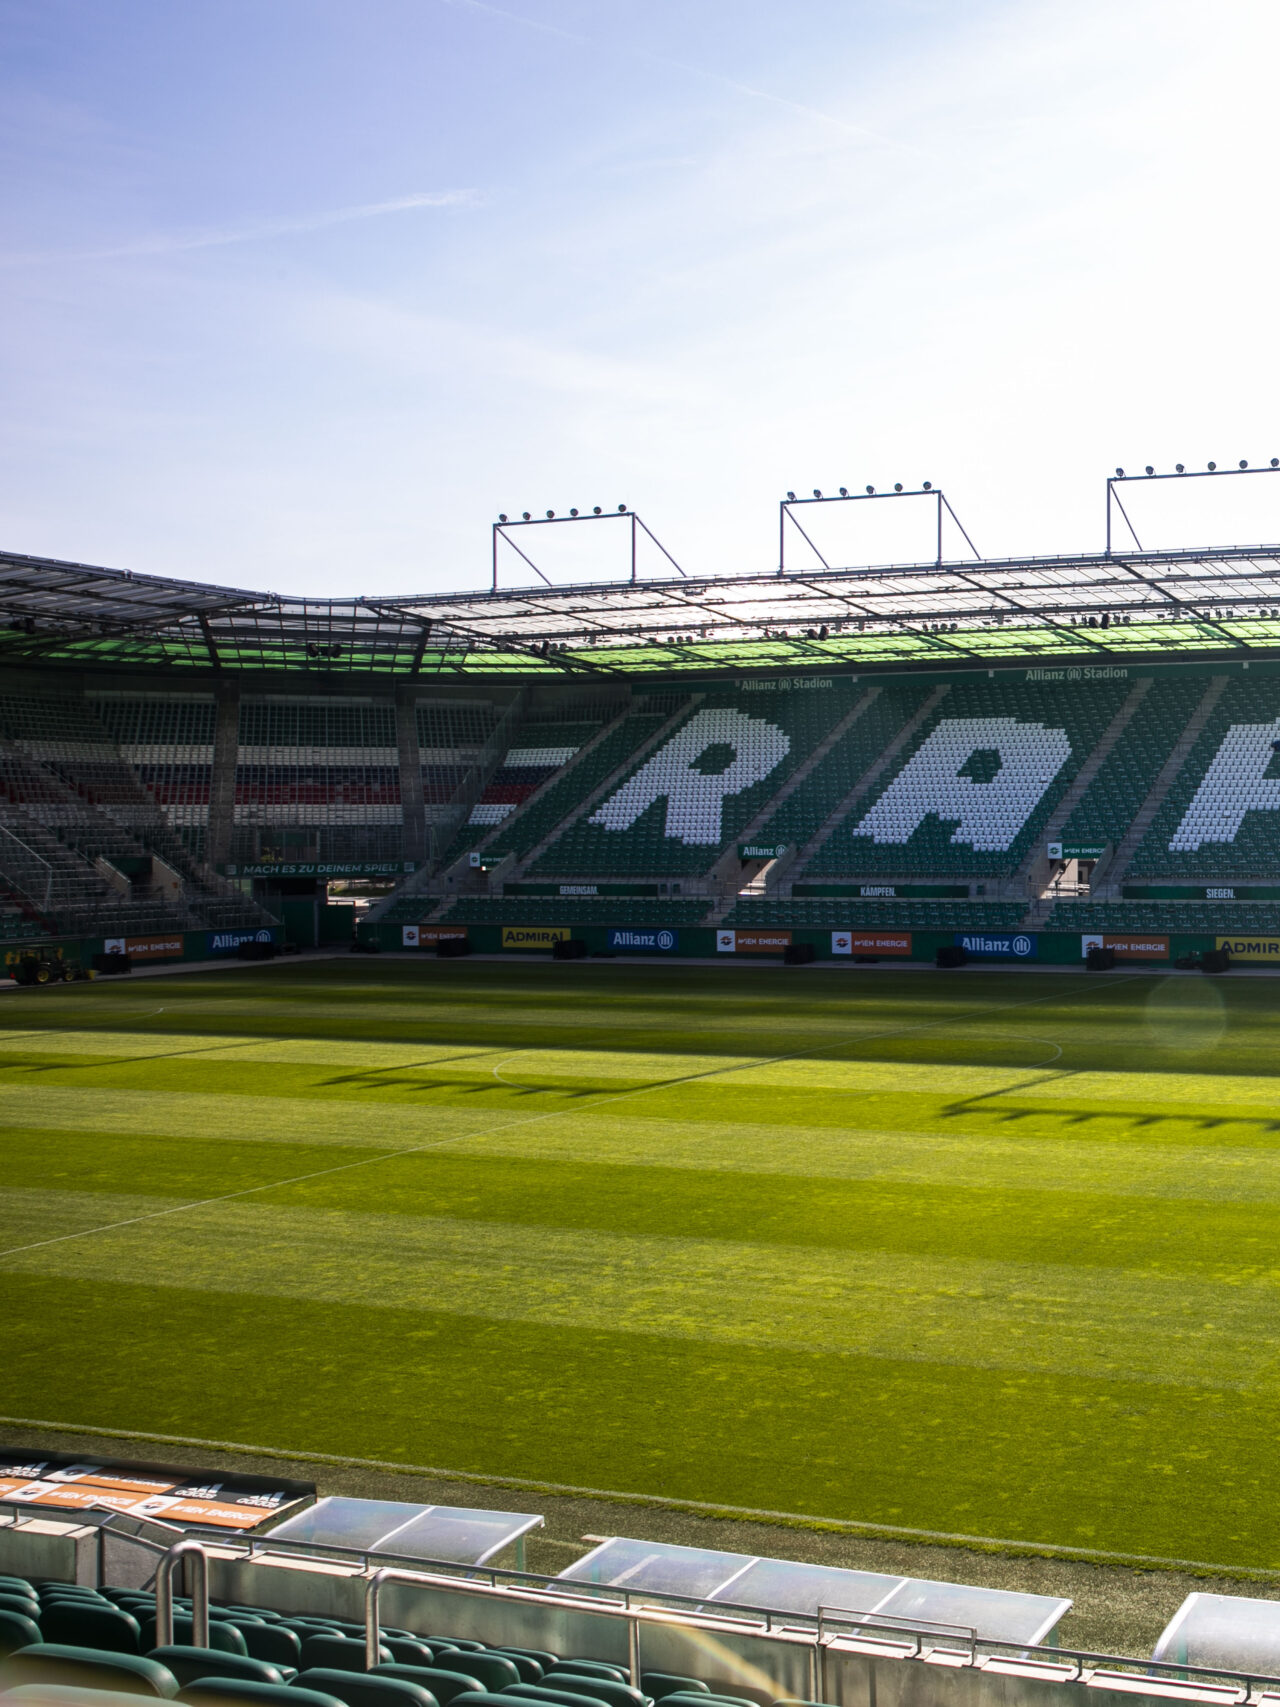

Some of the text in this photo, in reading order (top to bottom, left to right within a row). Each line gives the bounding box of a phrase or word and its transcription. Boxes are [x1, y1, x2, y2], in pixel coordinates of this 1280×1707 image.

[1025, 667, 1128, 680] Allianz Stadion
[741, 678, 833, 690] Allianz Stadion
[743, 846, 774, 856] Allianz
[243, 863, 399, 874] MACH ES ZU DEINEM SPIEL!
[1206, 888, 1236, 899] SIEGEN.
[613, 932, 656, 946] Allianz
[962, 937, 1010, 952] Allianz
[1130, 943, 1166, 952] ENERGIE
